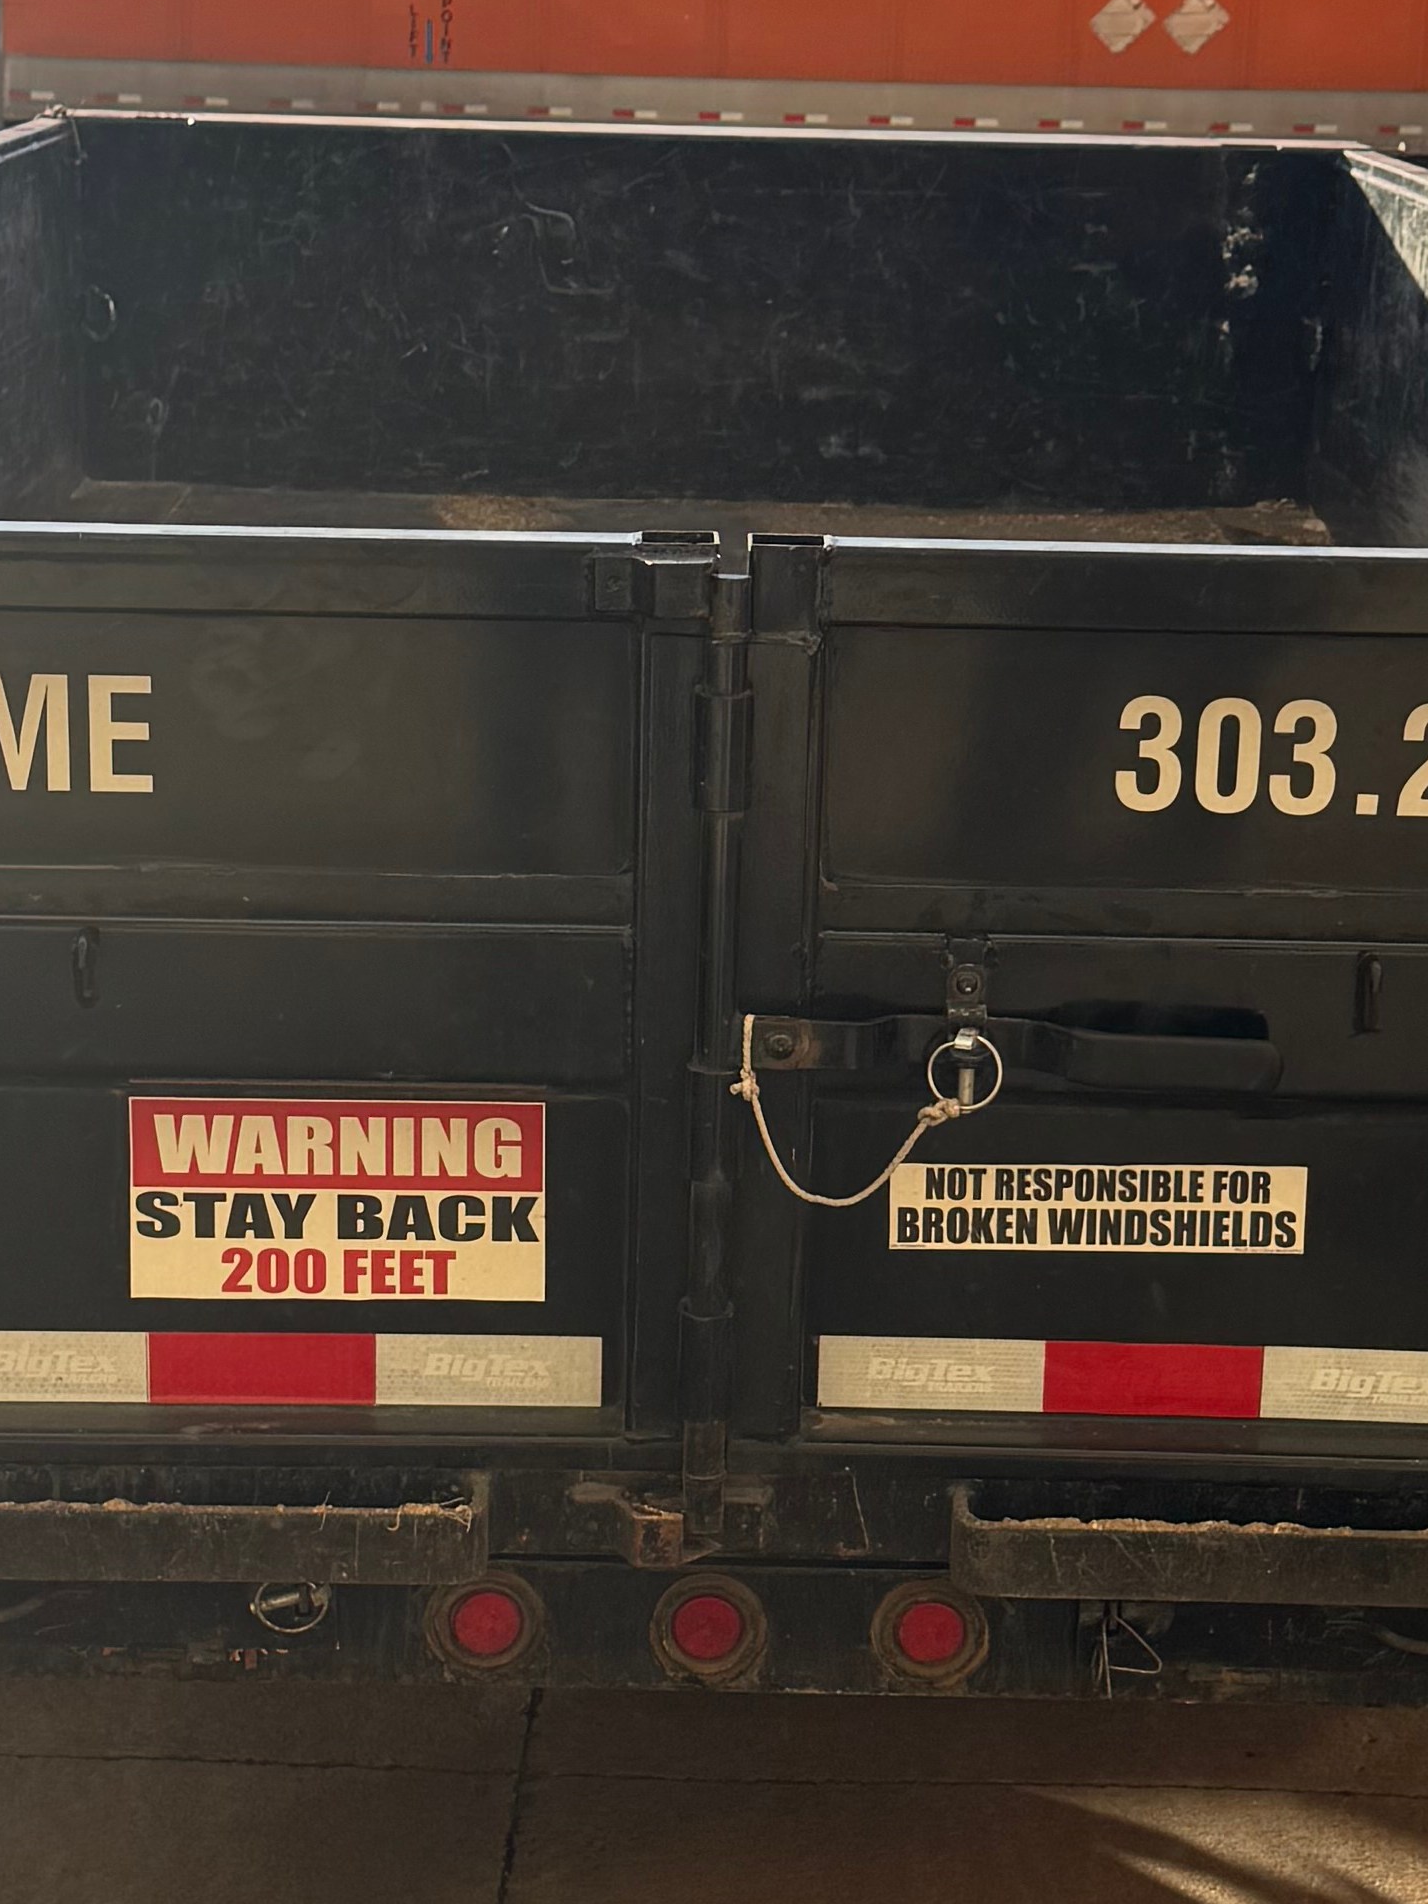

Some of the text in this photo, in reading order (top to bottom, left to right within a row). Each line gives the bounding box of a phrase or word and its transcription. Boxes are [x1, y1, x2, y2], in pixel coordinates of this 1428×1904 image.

[153, 1113, 523, 1179] WARNING
[925, 1167, 1272, 1205] NOT RESPONSIBLE FOR
[134, 1191, 541, 1243] STAY BACK
[896, 1206, 1298, 1249] BROKEN WINDSHIELDS
[220, 1247, 458, 1295] 200 FEET
[424, 1353, 552, 1382] BigTex
